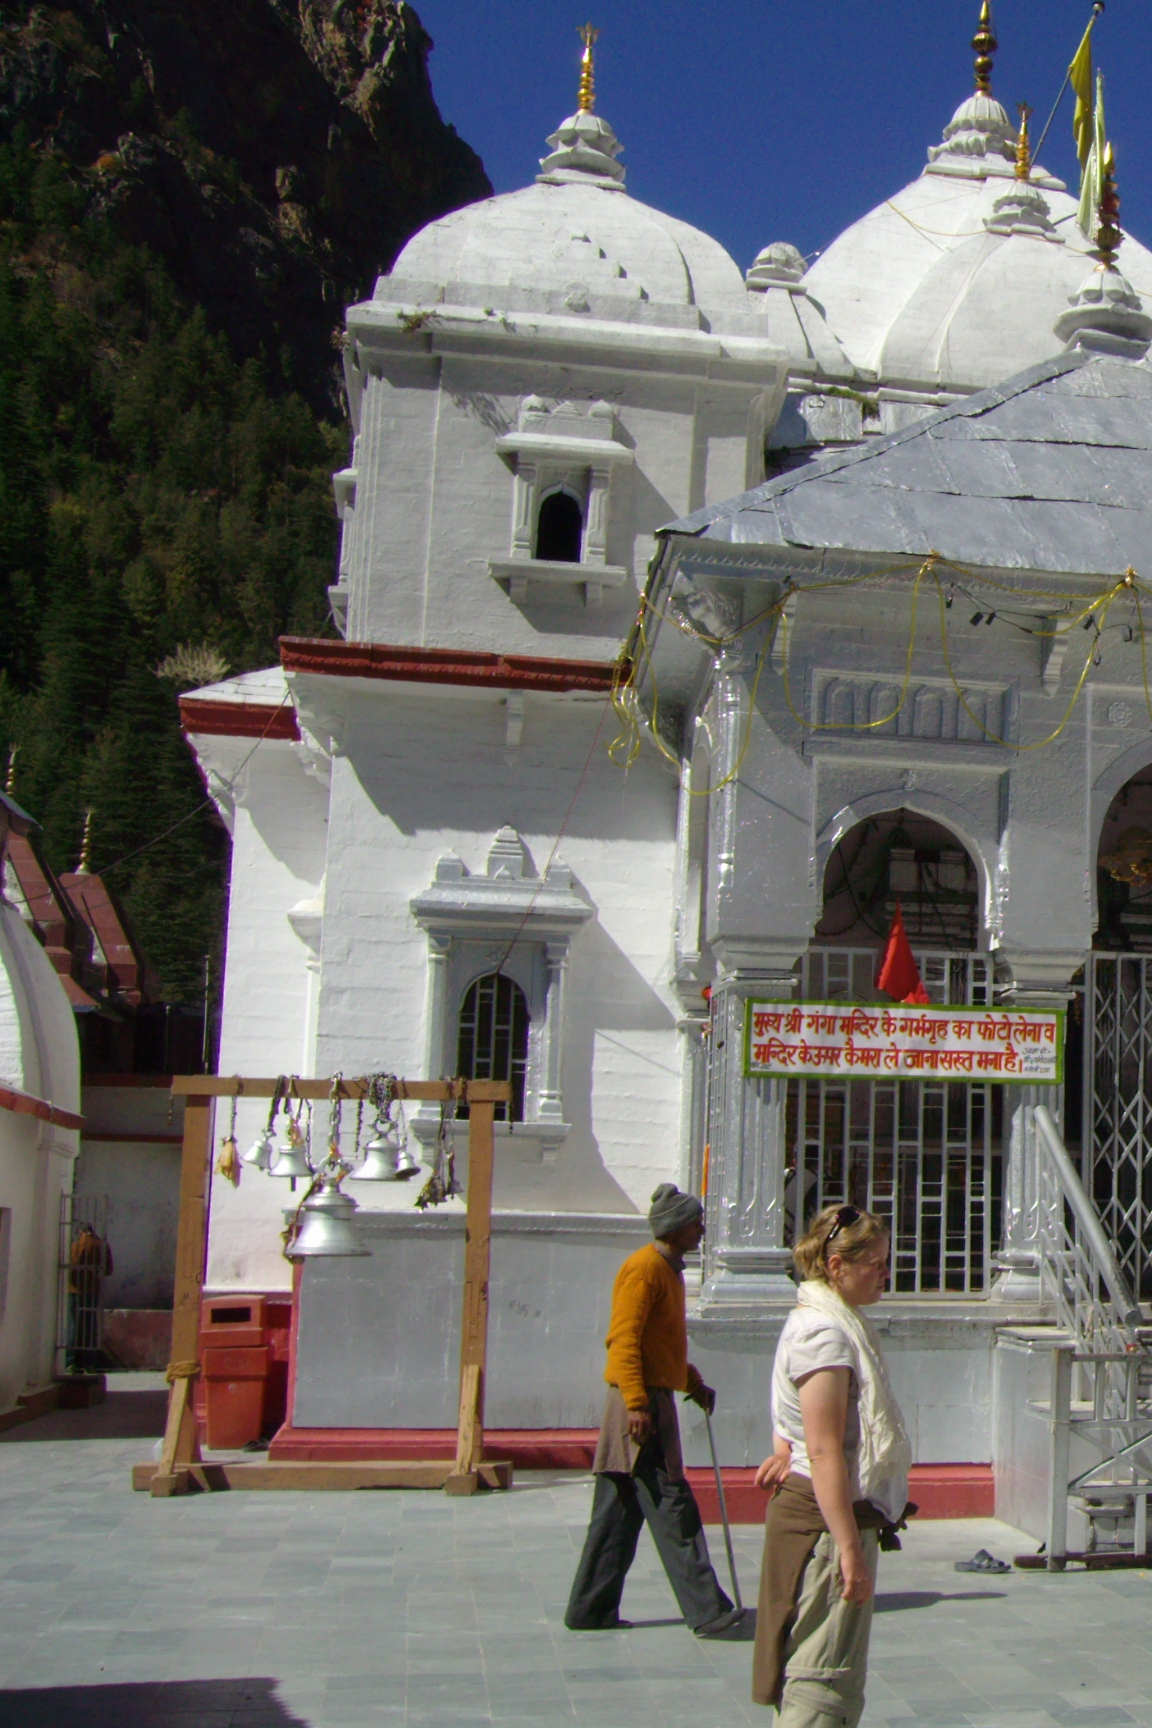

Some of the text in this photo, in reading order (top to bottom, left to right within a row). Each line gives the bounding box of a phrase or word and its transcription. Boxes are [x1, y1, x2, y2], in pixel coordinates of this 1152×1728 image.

[784, 1008, 804, 1034] श्री
[806, 1011, 838, 1035] गंगा
[839, 1008, 879, 1038] मन्दिर
[881, 1011, 897, 1037] के
[952, 1020, 975, 1040] का
[1013, 1015, 1043, 1044] लेना
[1044, 1023, 1056, 1044] व
[753, 1037, 796, 1066] मन्दिर
[844, 1037, 883, 1068] कैमरा
[884, 1042, 901, 1069] ले
